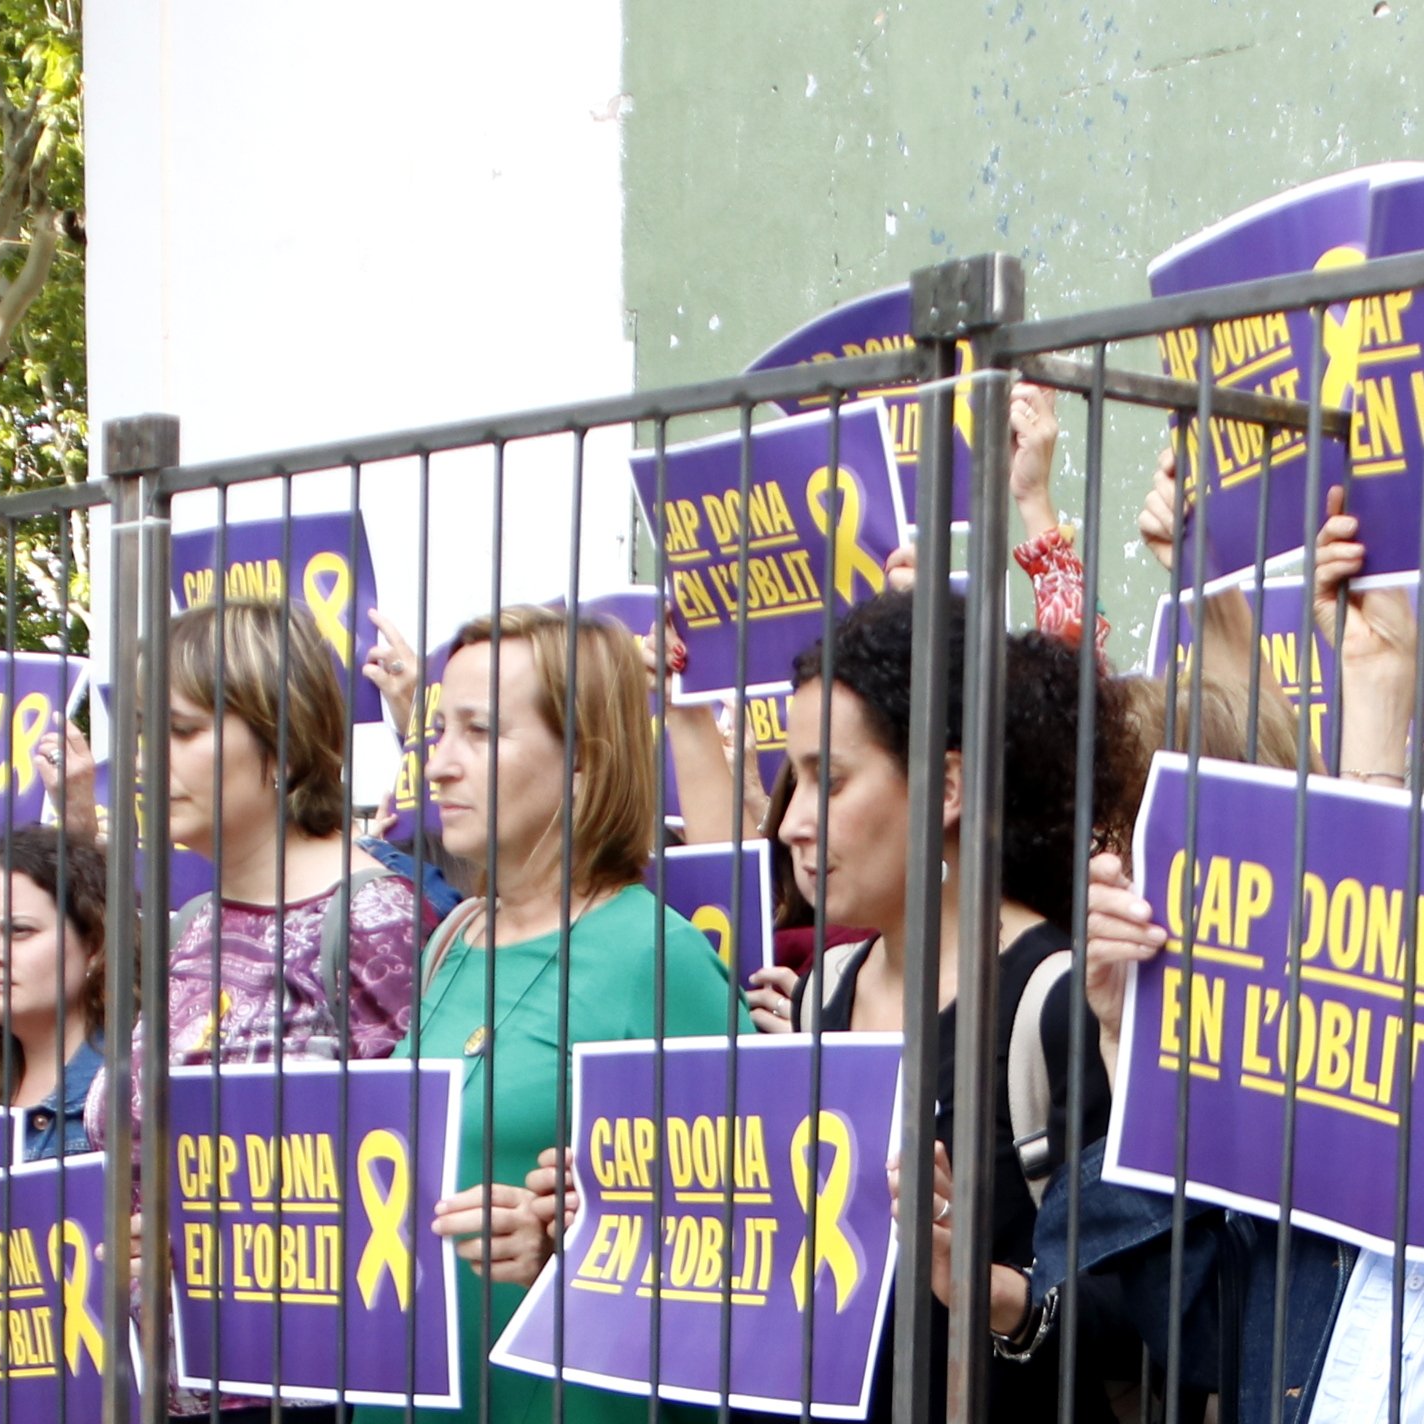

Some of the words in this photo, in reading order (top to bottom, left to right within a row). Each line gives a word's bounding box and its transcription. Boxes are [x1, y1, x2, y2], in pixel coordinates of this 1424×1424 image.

[1351, 377, 1403, 459] EN
[226, 559, 283, 600] ONA
[673, 569, 717, 618] EN
[1167, 848, 1273, 949] CAP
[1160, 966, 1225, 1063] EN
[178, 1134, 238, 1198] CAP
[590, 1117, 655, 1187] CAP
[578, 1215, 643, 1282] EN
